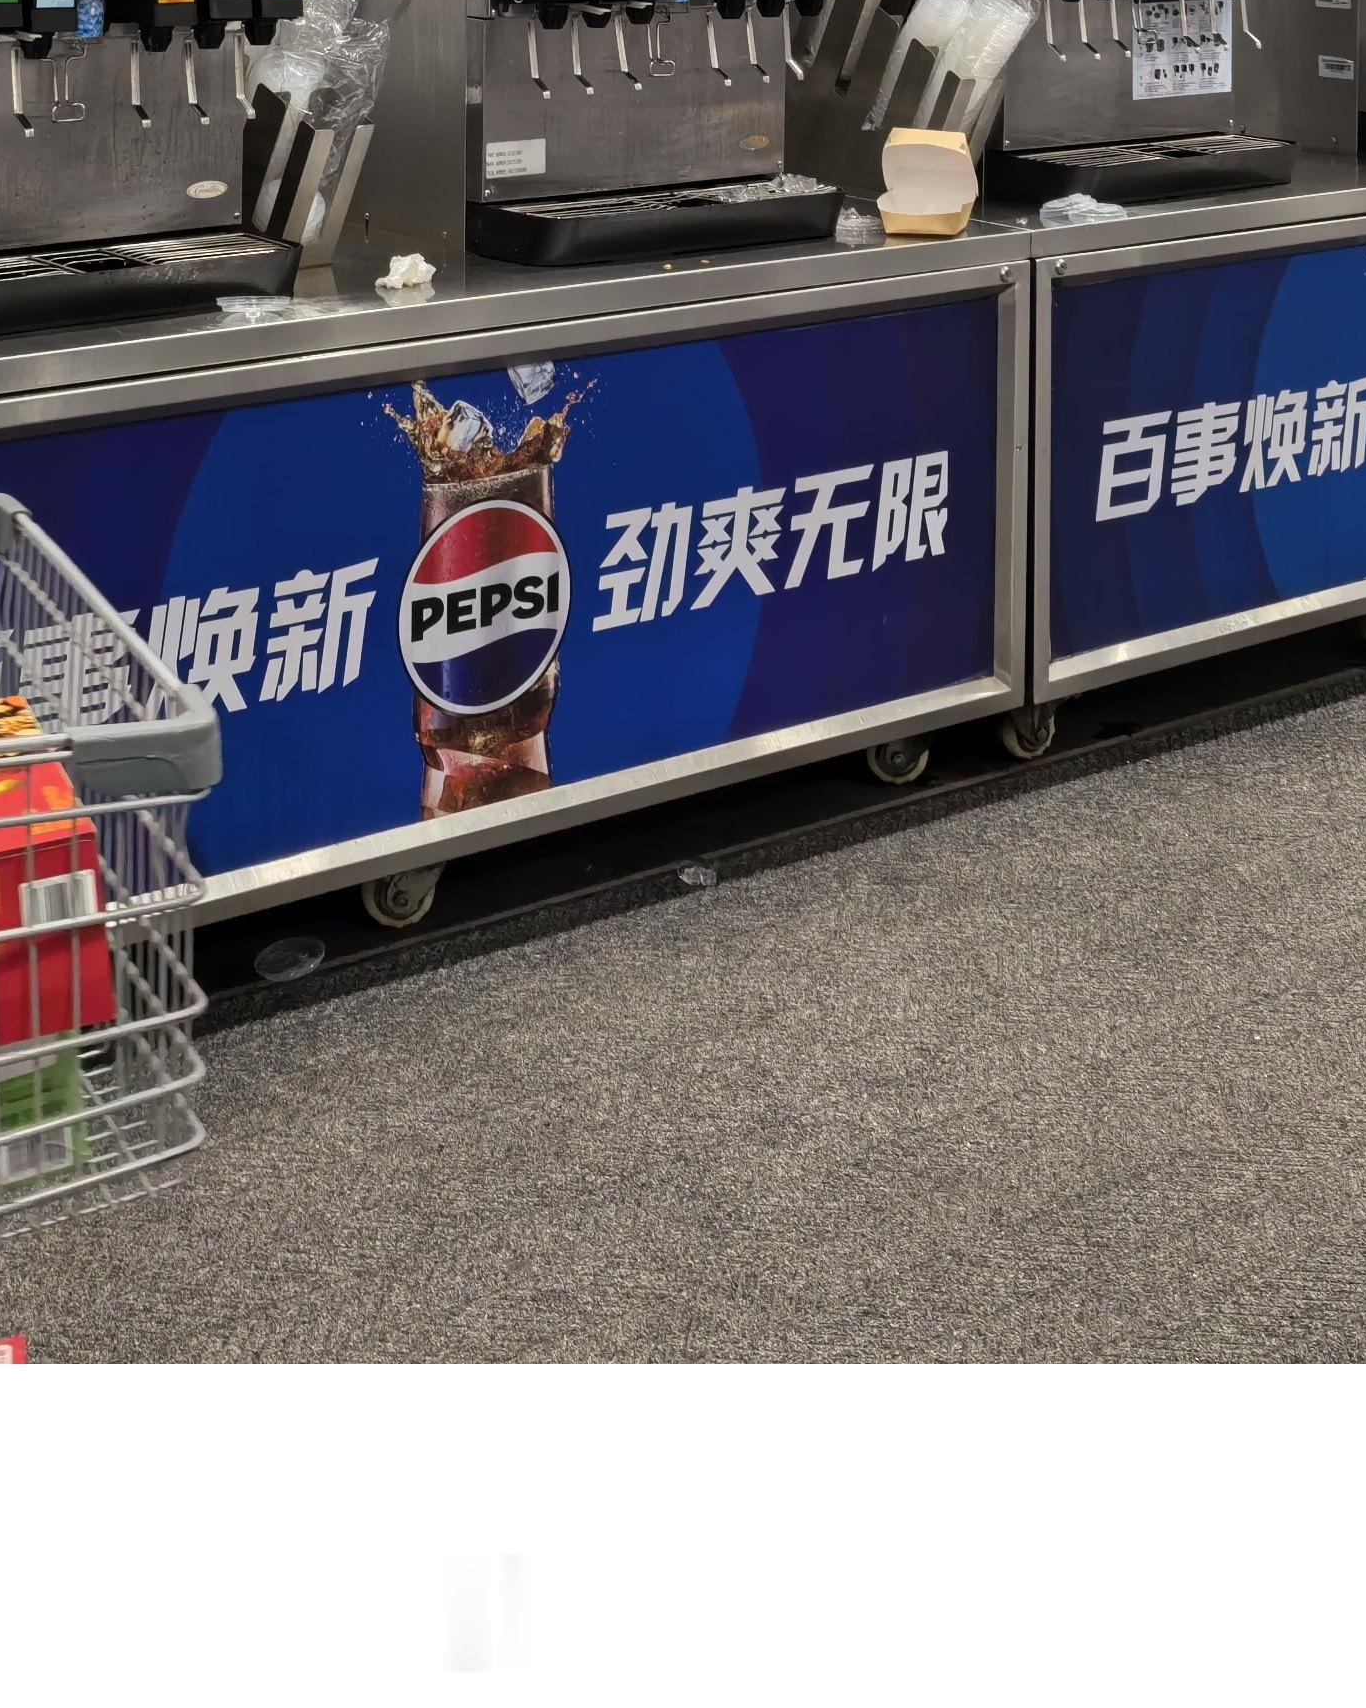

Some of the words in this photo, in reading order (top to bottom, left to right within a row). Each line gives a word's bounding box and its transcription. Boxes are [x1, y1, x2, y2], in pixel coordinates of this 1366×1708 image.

[593, 451, 949, 632] 劲爽无限
[411, 573, 560, 644] PEPSI
